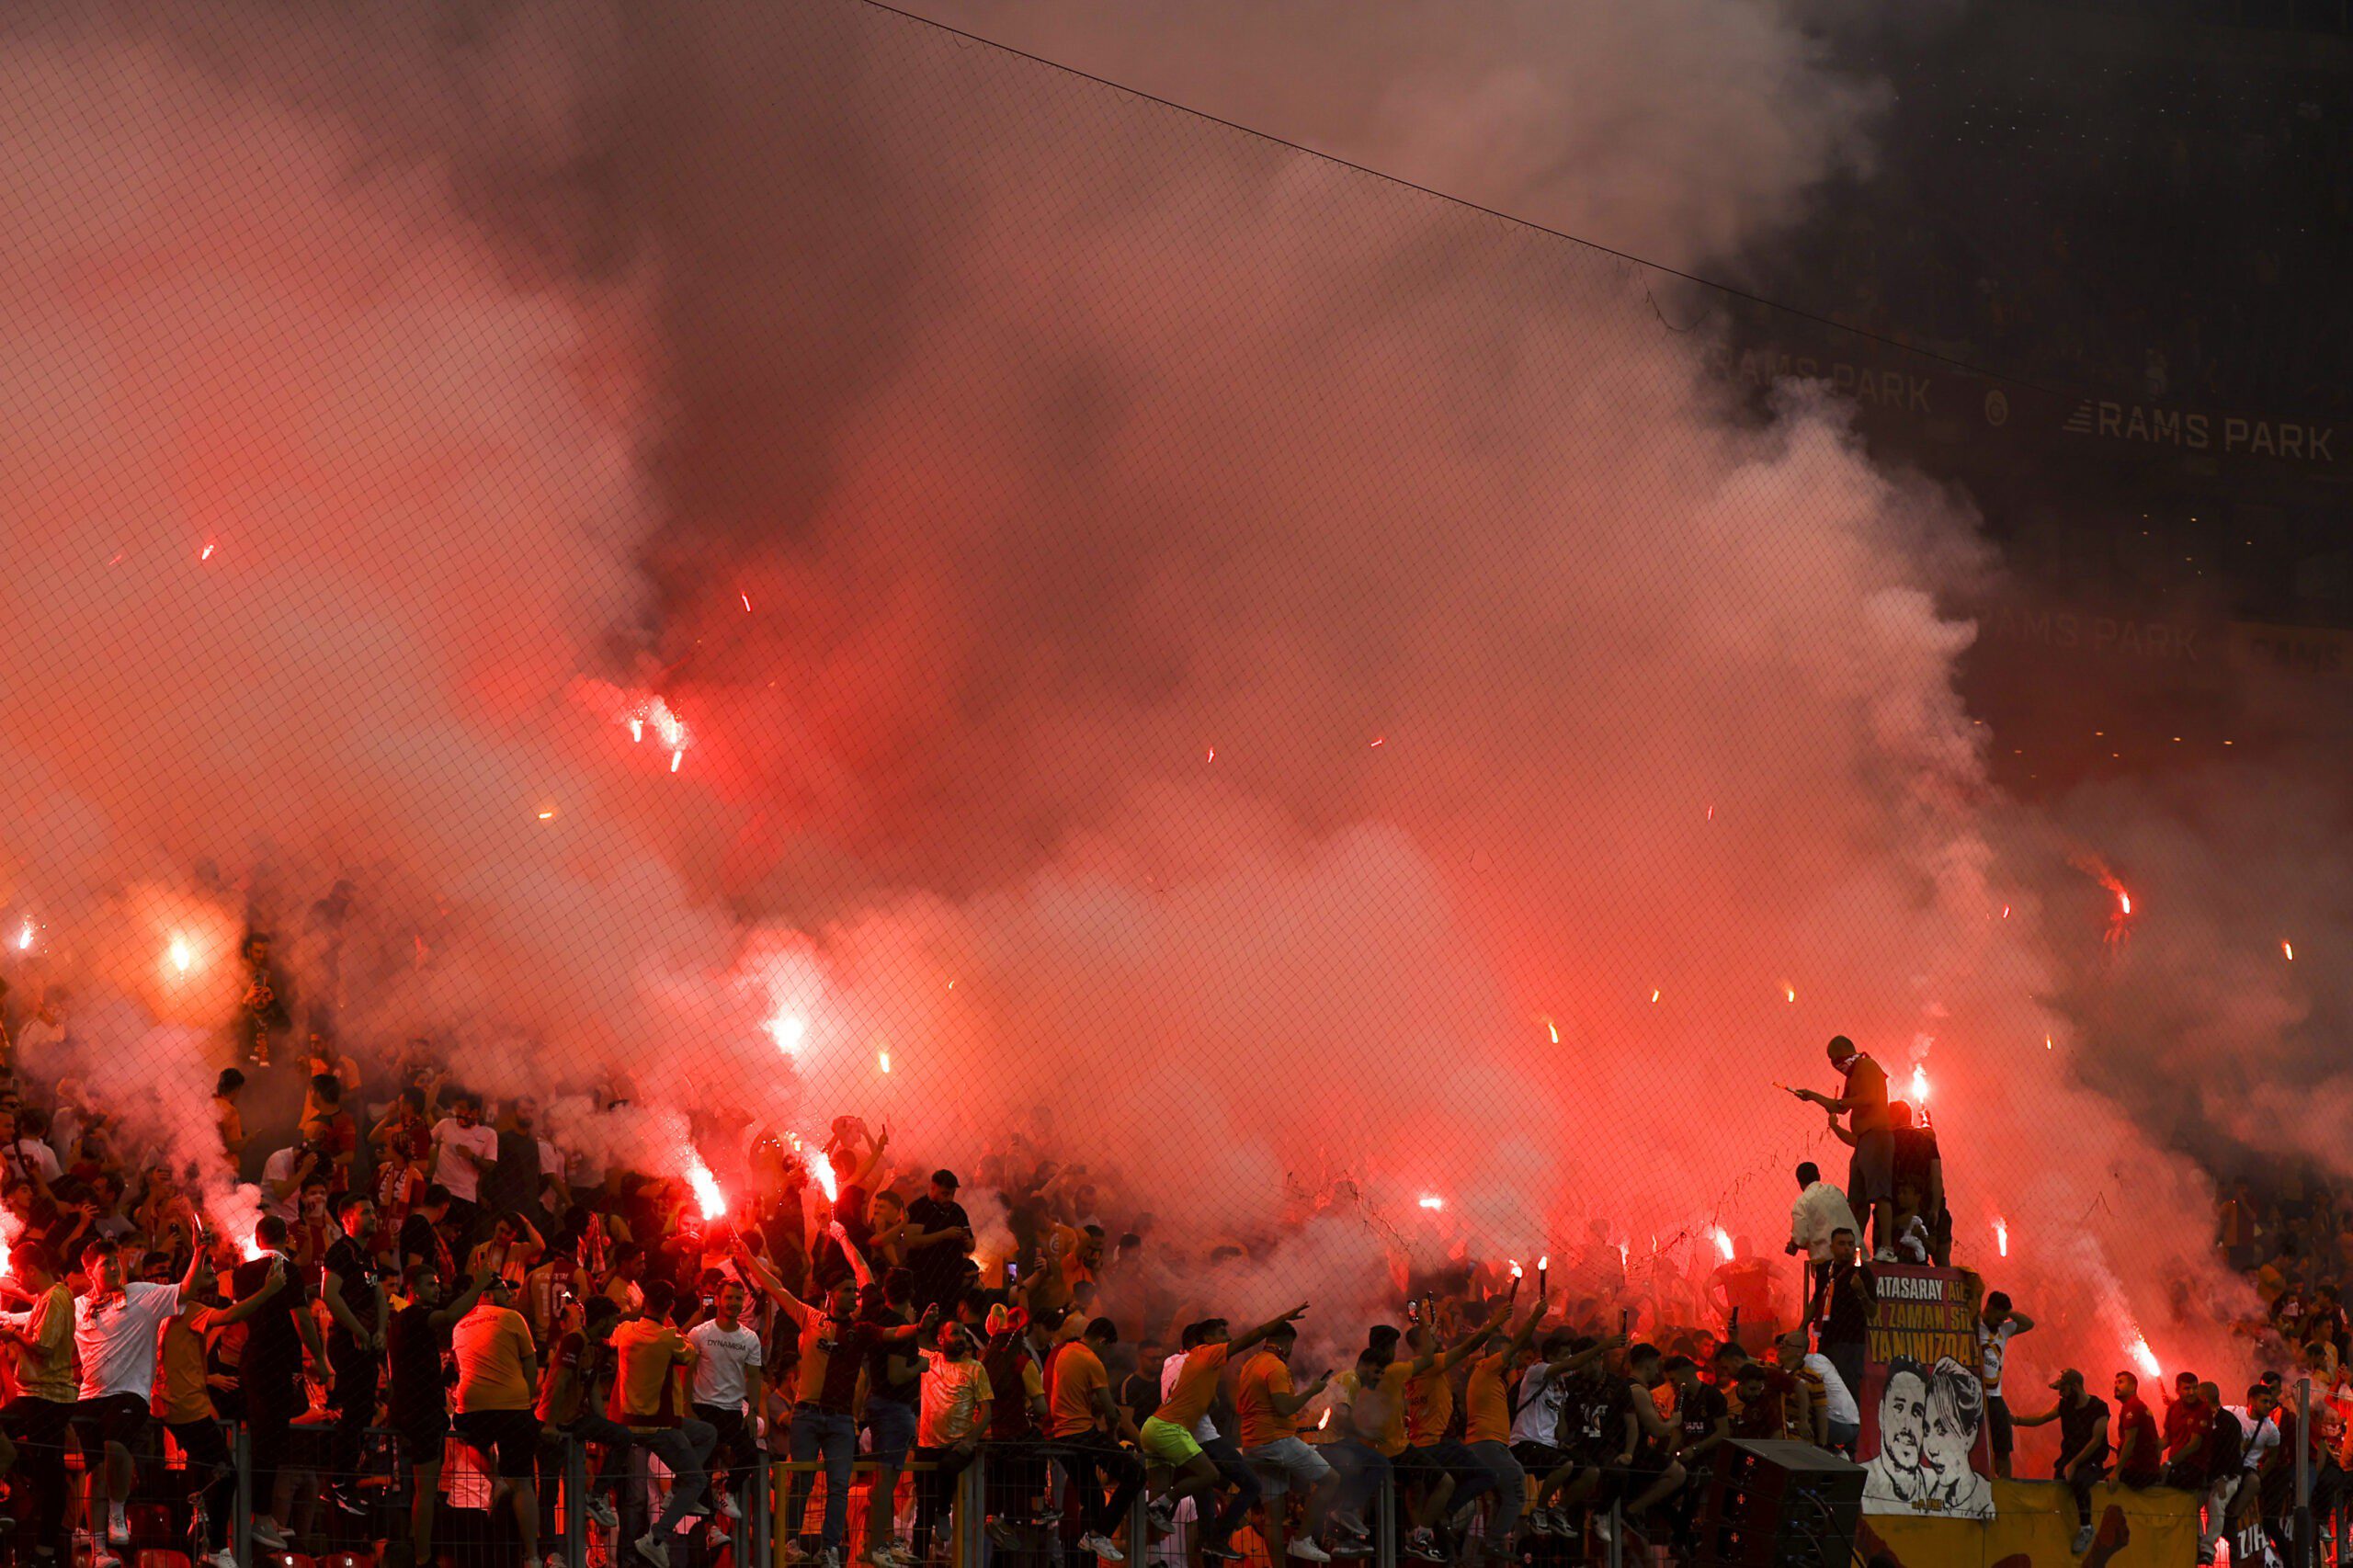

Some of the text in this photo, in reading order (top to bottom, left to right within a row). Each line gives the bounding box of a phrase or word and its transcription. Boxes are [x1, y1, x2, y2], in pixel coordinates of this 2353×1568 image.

[1833, 362, 1932, 414] PARK
[2097, 401, 2335, 462] RAMS PARK
[2094, 616, 2200, 662] PARK
[540, 1282, 567, 1318] 10
[1876, 1276, 1943, 1301] ATASARAY
[1888, 1301, 1945, 1331] ZAMAN
[707, 1339, 746, 1351] DYNAMISM
